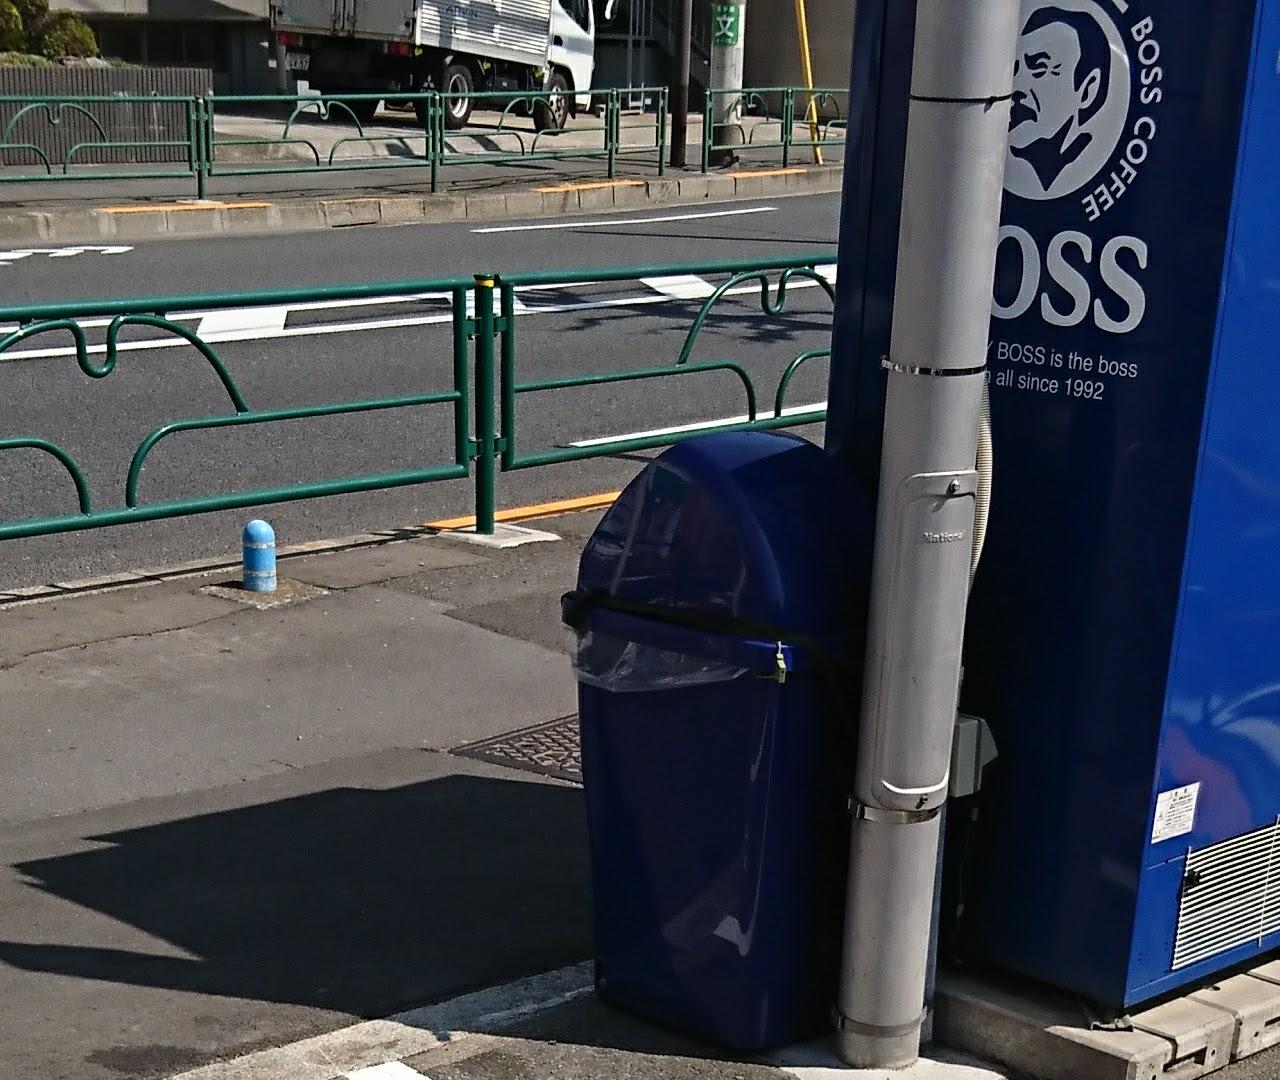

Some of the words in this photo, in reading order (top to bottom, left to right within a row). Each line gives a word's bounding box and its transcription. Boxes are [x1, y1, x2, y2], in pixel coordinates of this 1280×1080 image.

[1131, 16, 1163, 104] BOSS
[1082, 117, 1156, 222] COFFEE
[991, 224, 1148, 333] OSS
[996, 368, 1014, 387] all
[1017, 372, 1059, 394] since
[1065, 378, 1105, 400] 1992
[997, 341, 1046, 366] BOSS
[1050, 348, 1063, 368] is
[1068, 351, 1094, 372] the
[1098, 355, 1139, 378] boss
